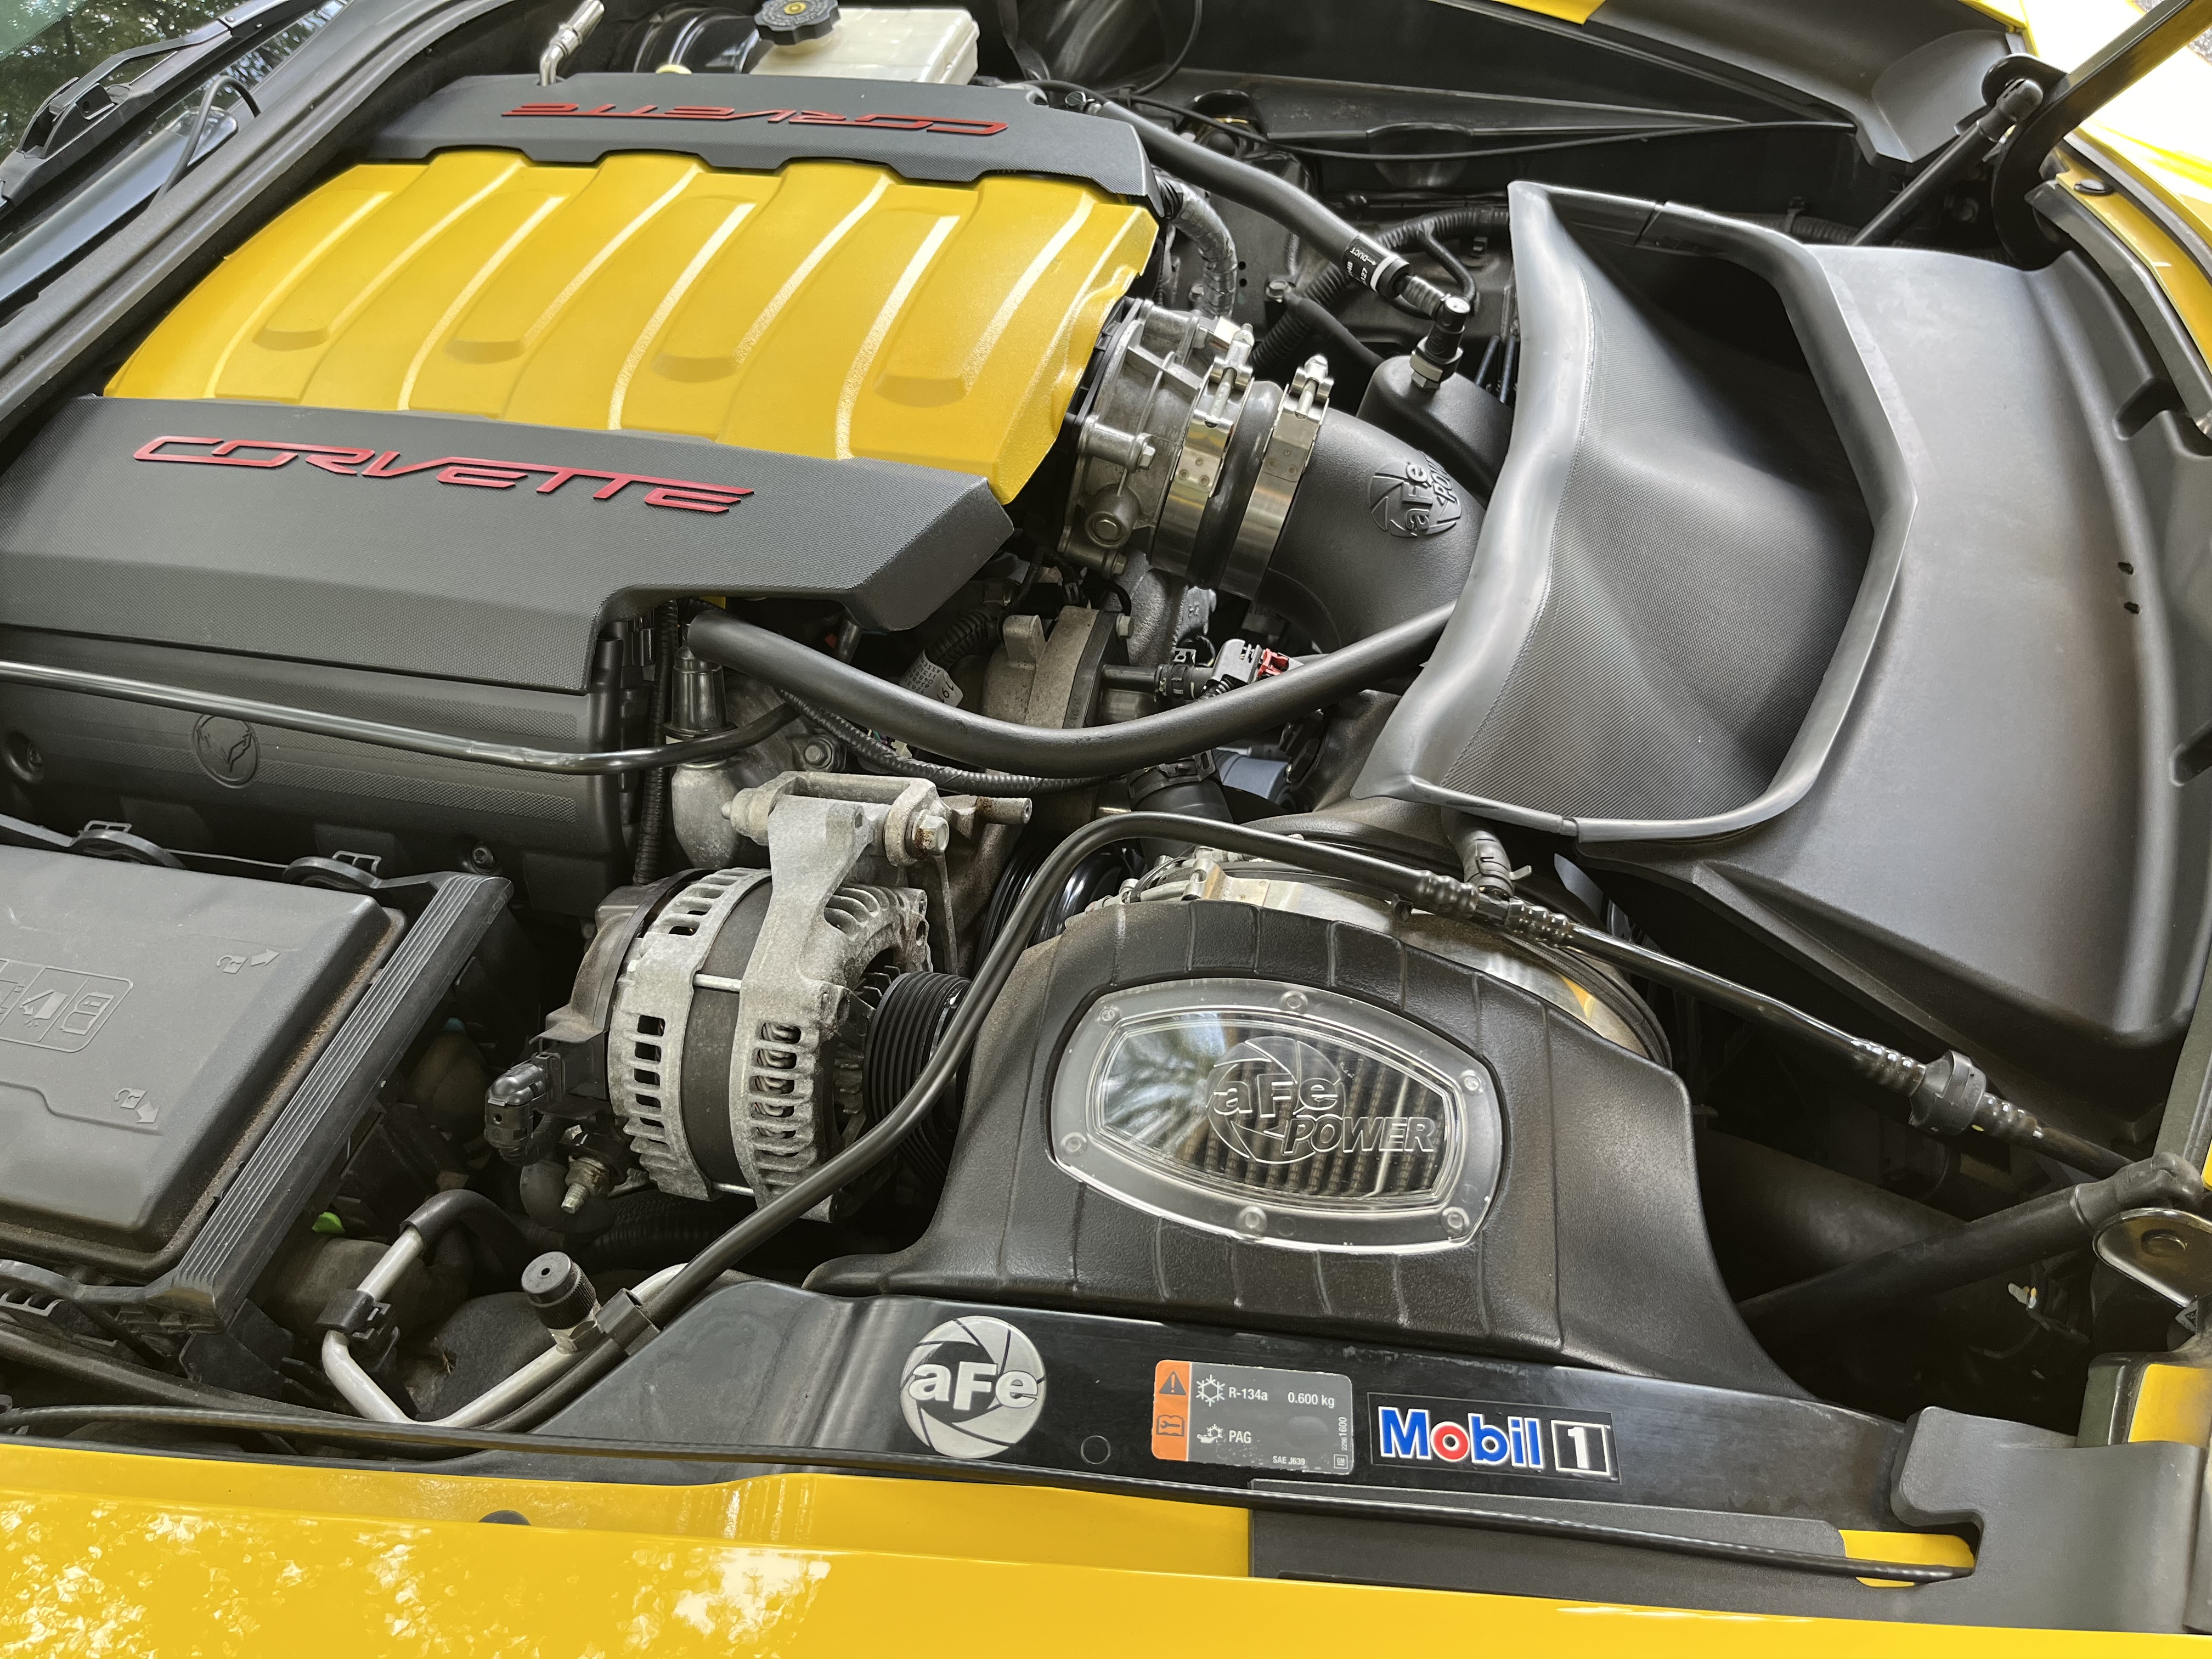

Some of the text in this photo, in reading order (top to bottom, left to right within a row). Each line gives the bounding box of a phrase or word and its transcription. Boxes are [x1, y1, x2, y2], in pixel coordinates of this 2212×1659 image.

[501, 103, 1008, 136] CORVETTE
[1350, 247, 1369, 262] DUCT
[133, 435, 755, 514] CORVETTE
[1402, 464, 1434, 531] aFe
[1213, 1073, 1338, 1118] aFe
[1282, 1115, 1436, 1156] POWER
[909, 1361, 1038, 1410] aFe
[1228, 1386, 1268, 1401] R-134a
[1288, 1391, 1335, 1409] 0.600 kg
[1228, 1430, 1252, 1444] PAG
[1378, 1406, 1544, 1469] Mobil
[1272, 1455, 1306, 1466] SAE J639
